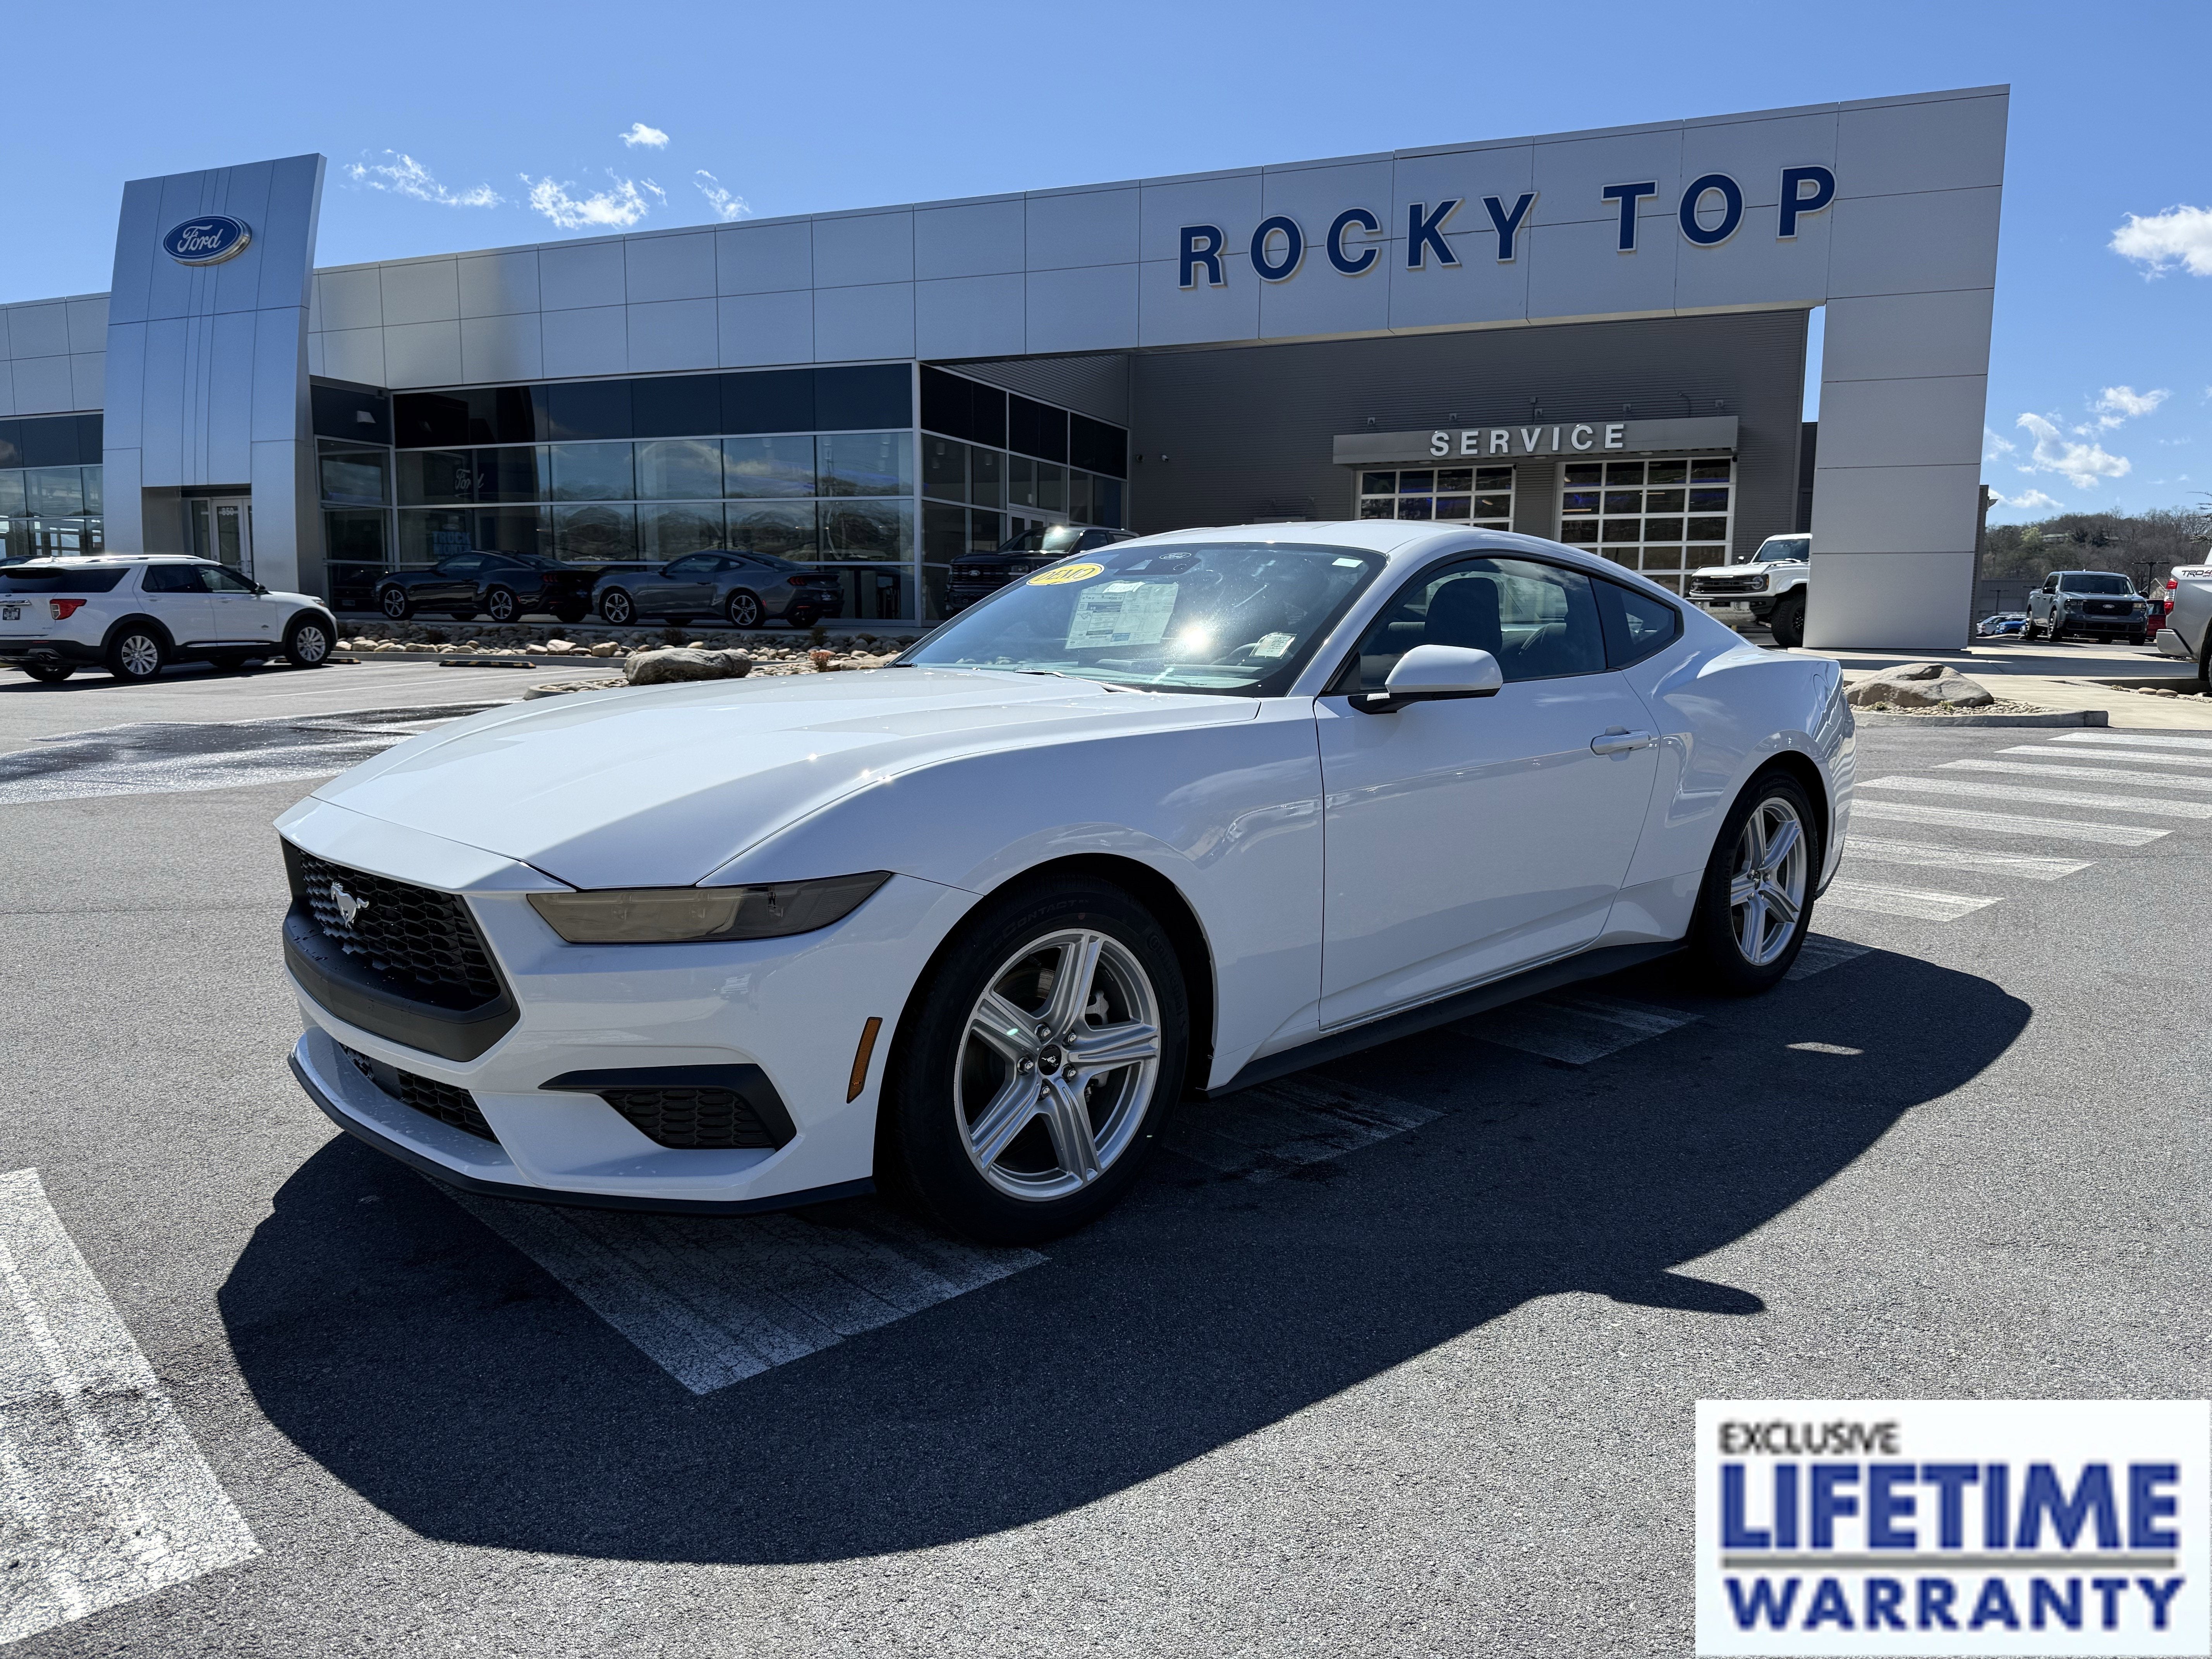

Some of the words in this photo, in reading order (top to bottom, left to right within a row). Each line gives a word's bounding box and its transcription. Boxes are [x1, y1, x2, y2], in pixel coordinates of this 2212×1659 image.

[177, 225, 223, 252] Ford
[1178, 191, 1539, 290] ROCKY
[1601, 164, 1838, 253] TOP
[1430, 423, 1624, 457] SERVICE
[1033, 568, 1096, 582] DEMO
